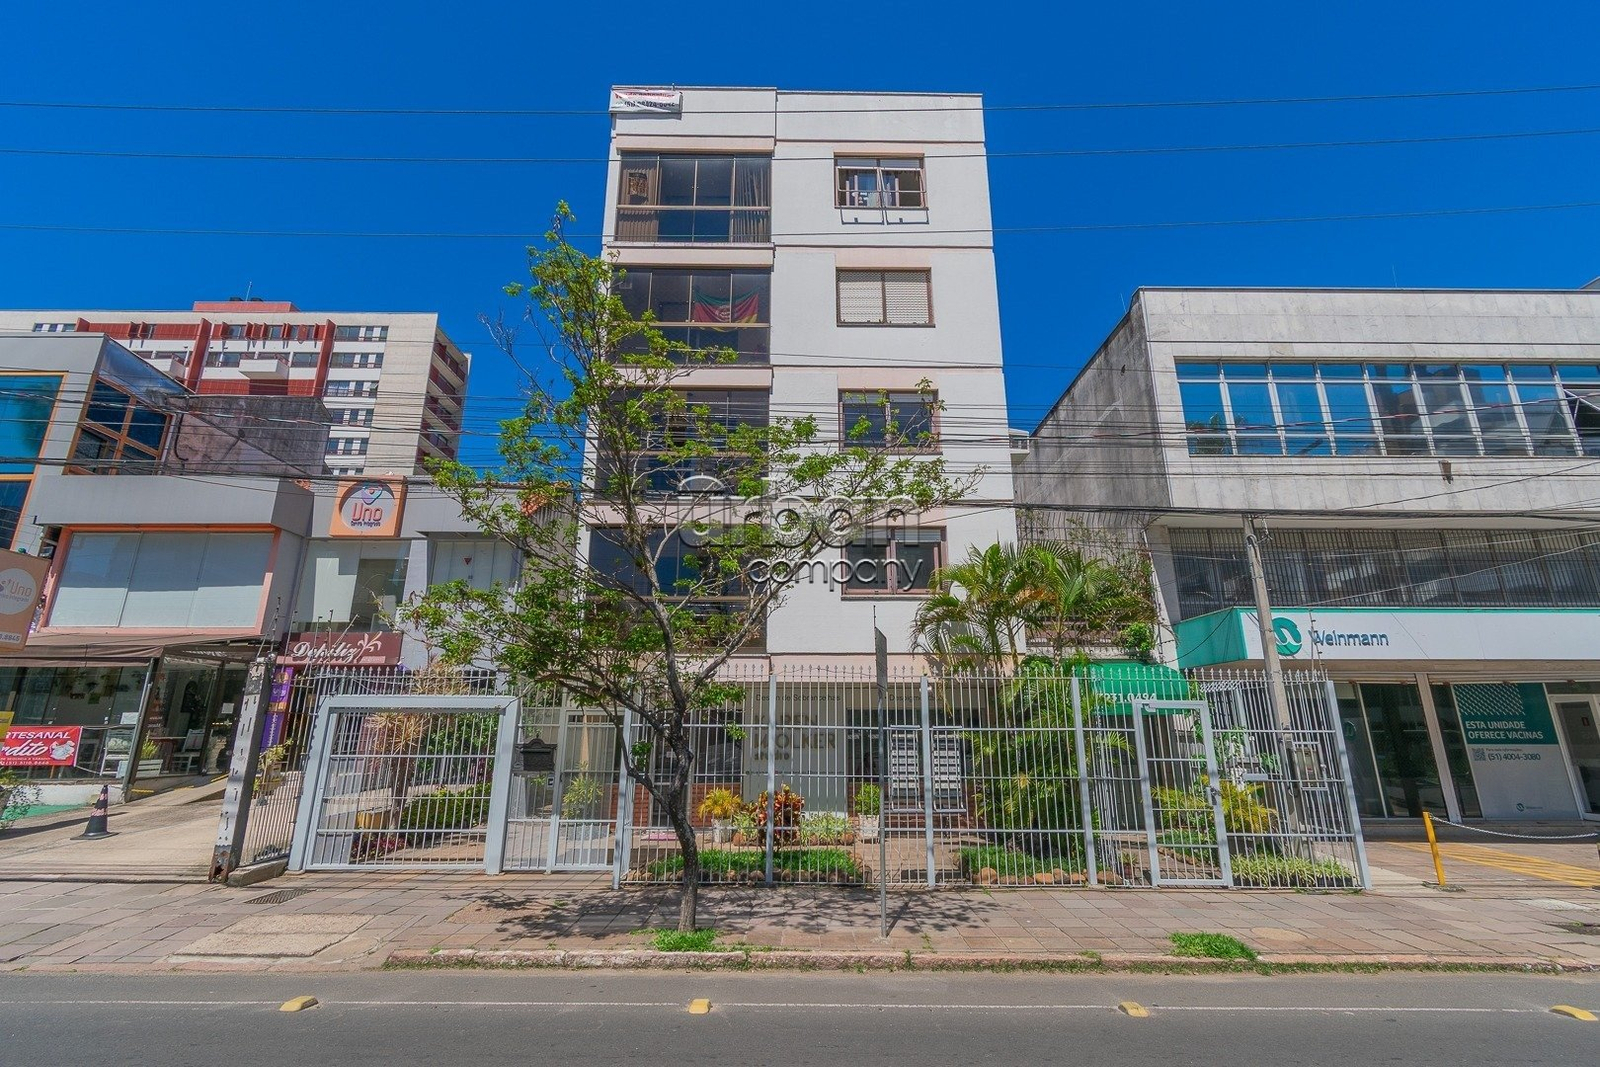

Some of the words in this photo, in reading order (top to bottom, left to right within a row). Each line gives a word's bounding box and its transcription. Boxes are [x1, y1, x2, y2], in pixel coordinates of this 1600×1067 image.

[351, 502, 383, 522] Uno
[10, 581, 32, 597] Uno
[1308, 629, 1389, 647] Weinmann
[1465, 721, 1487, 729] ESTA
[1488, 721, 1527, 729] UNIDADE
[1468, 731, 1507, 739] OFERECE
[1506, 731, 1544, 739] VACINAS
[1487, 753, 1502, 761] (51)
[1502, 753, 1541, 761] 4004-3080
